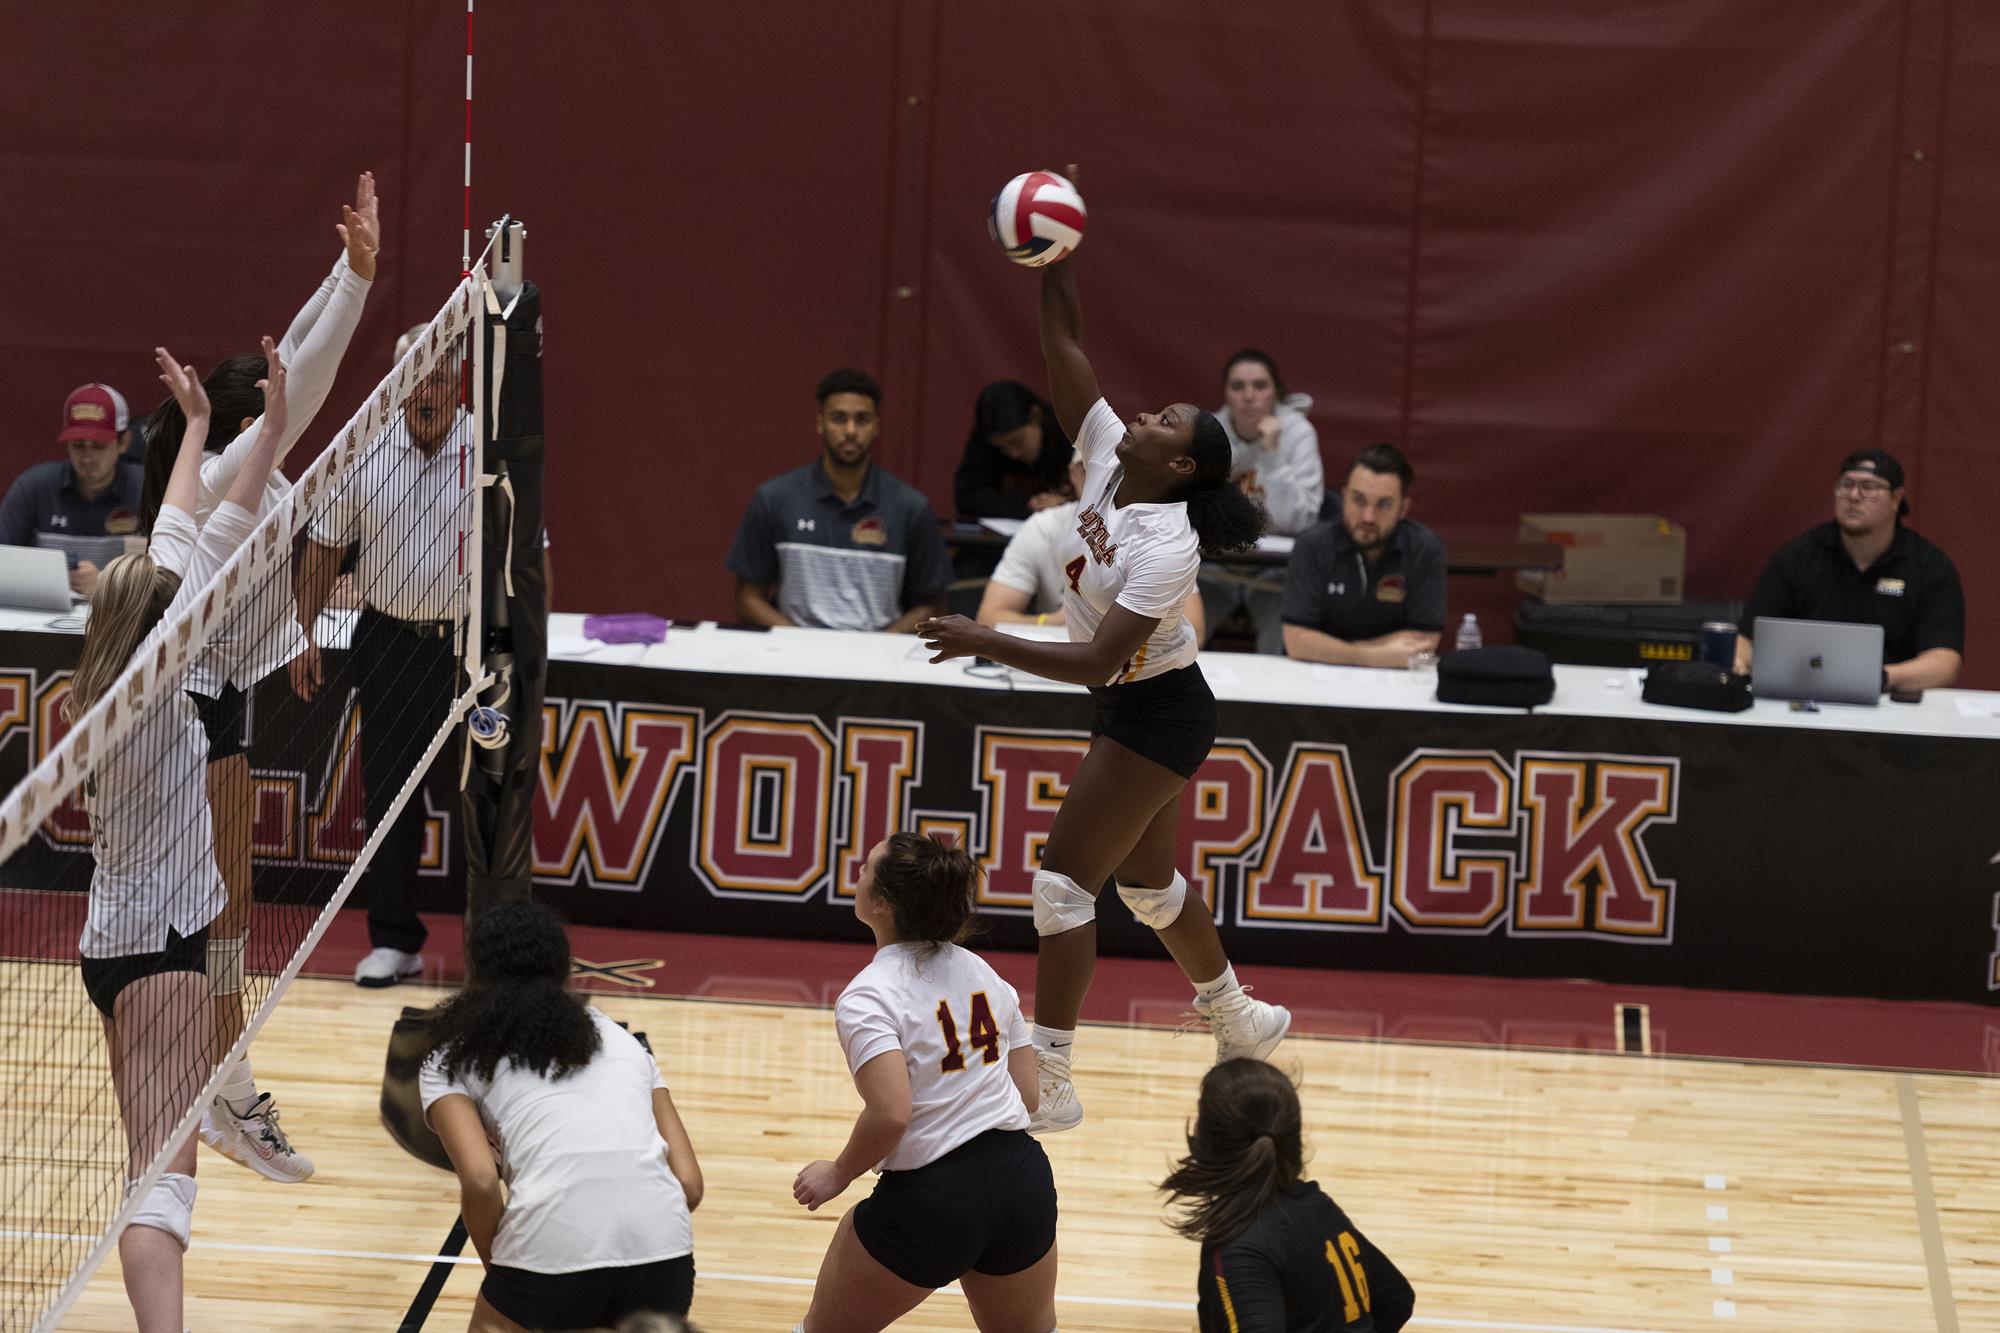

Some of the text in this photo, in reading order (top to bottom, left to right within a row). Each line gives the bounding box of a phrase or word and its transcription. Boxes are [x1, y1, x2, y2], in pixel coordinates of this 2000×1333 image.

[1065, 553, 1087, 596] 4
[936, 991, 1000, 1075] 14
[1325, 1230, 1371, 1324] 16
